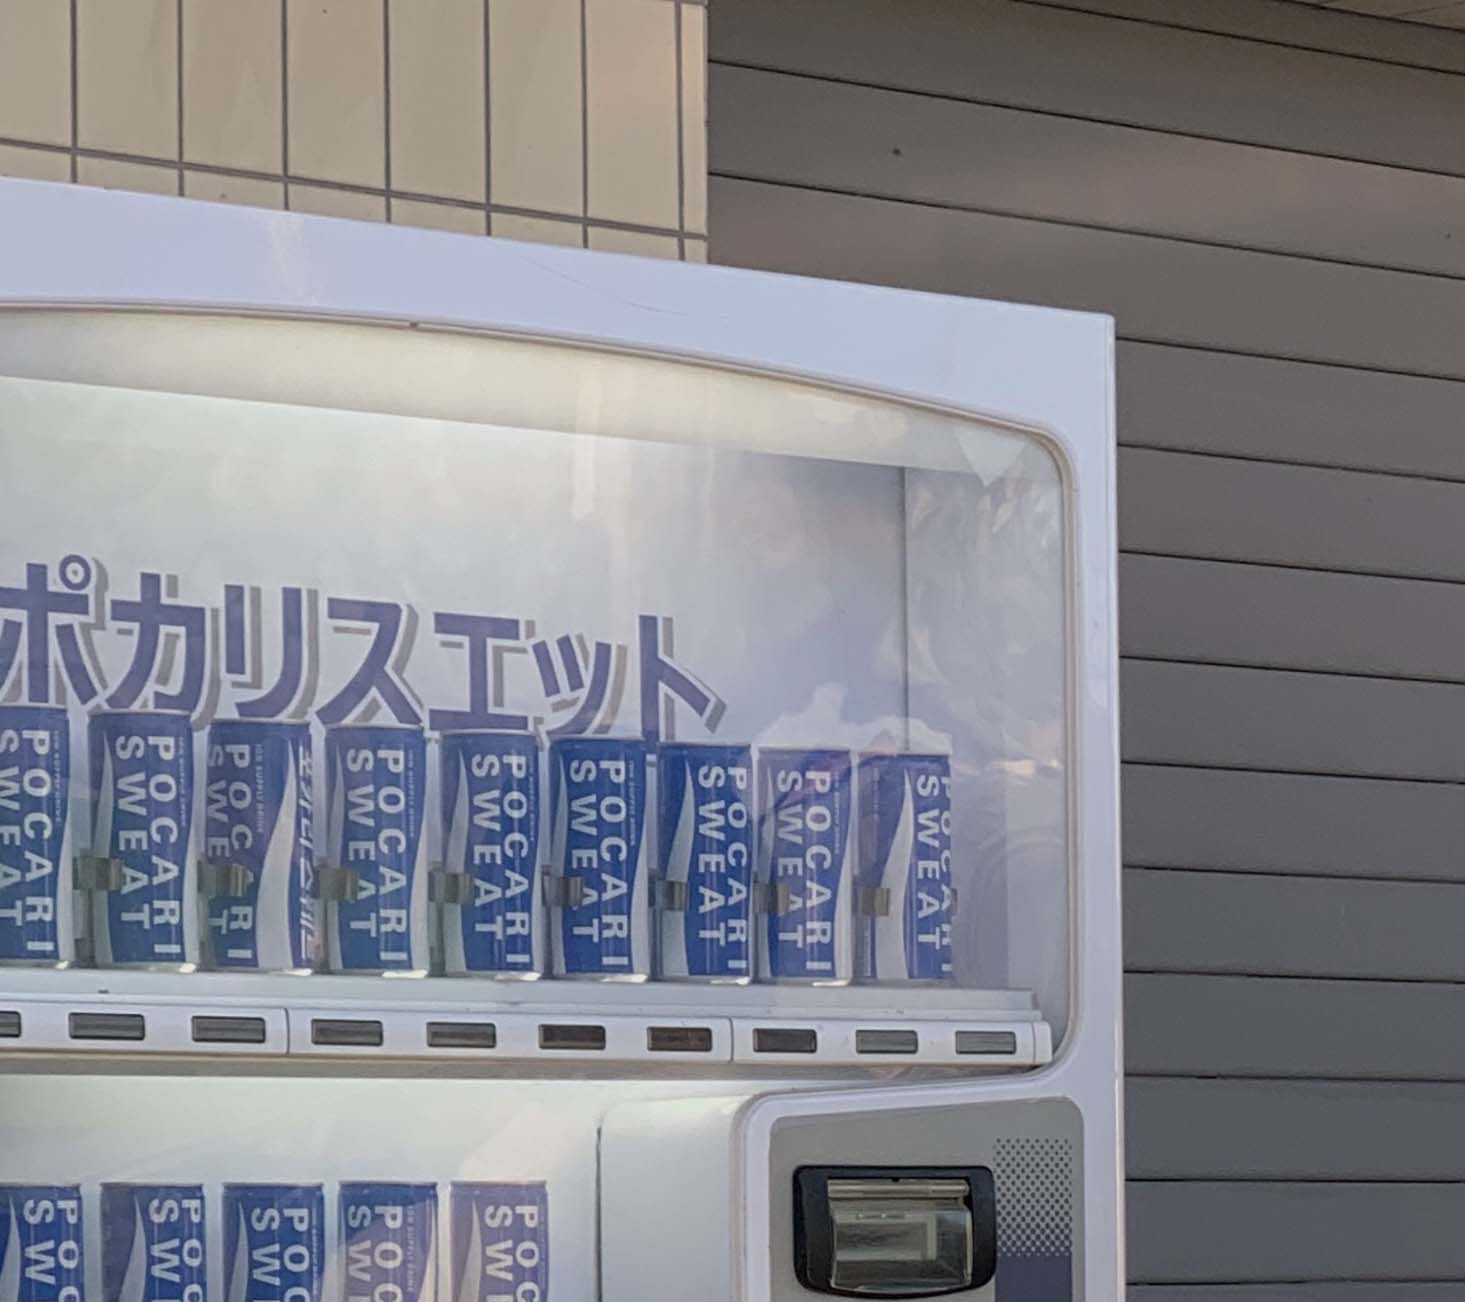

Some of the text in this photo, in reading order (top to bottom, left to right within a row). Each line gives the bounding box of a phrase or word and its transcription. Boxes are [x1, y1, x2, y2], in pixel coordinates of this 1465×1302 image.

[0, 554, 726, 742] ポカリスエット
[0, 729, 23, 926] SWEAT
[22, 729, 54, 951] POCARI
[115, 735, 150, 929] SWEAT
[148, 735, 181, 954] POCARI
[207, 744, 230, 935] SWET
[225, 744, 253, 959] POCRI
[347, 749, 377, 937] SWEAT
[377, 749, 407, 960] POCARI
[471, 754, 502, 940] SWEAT
[502, 755, 530, 963] POCARI
[599, 760, 628, 965] POCARI
[698, 765, 726, 947] SWEAT
[727, 766, 747, 969] POCARI
[805, 770, 832, 970] POCARI
[916, 774, 941, 950] SWEAT
